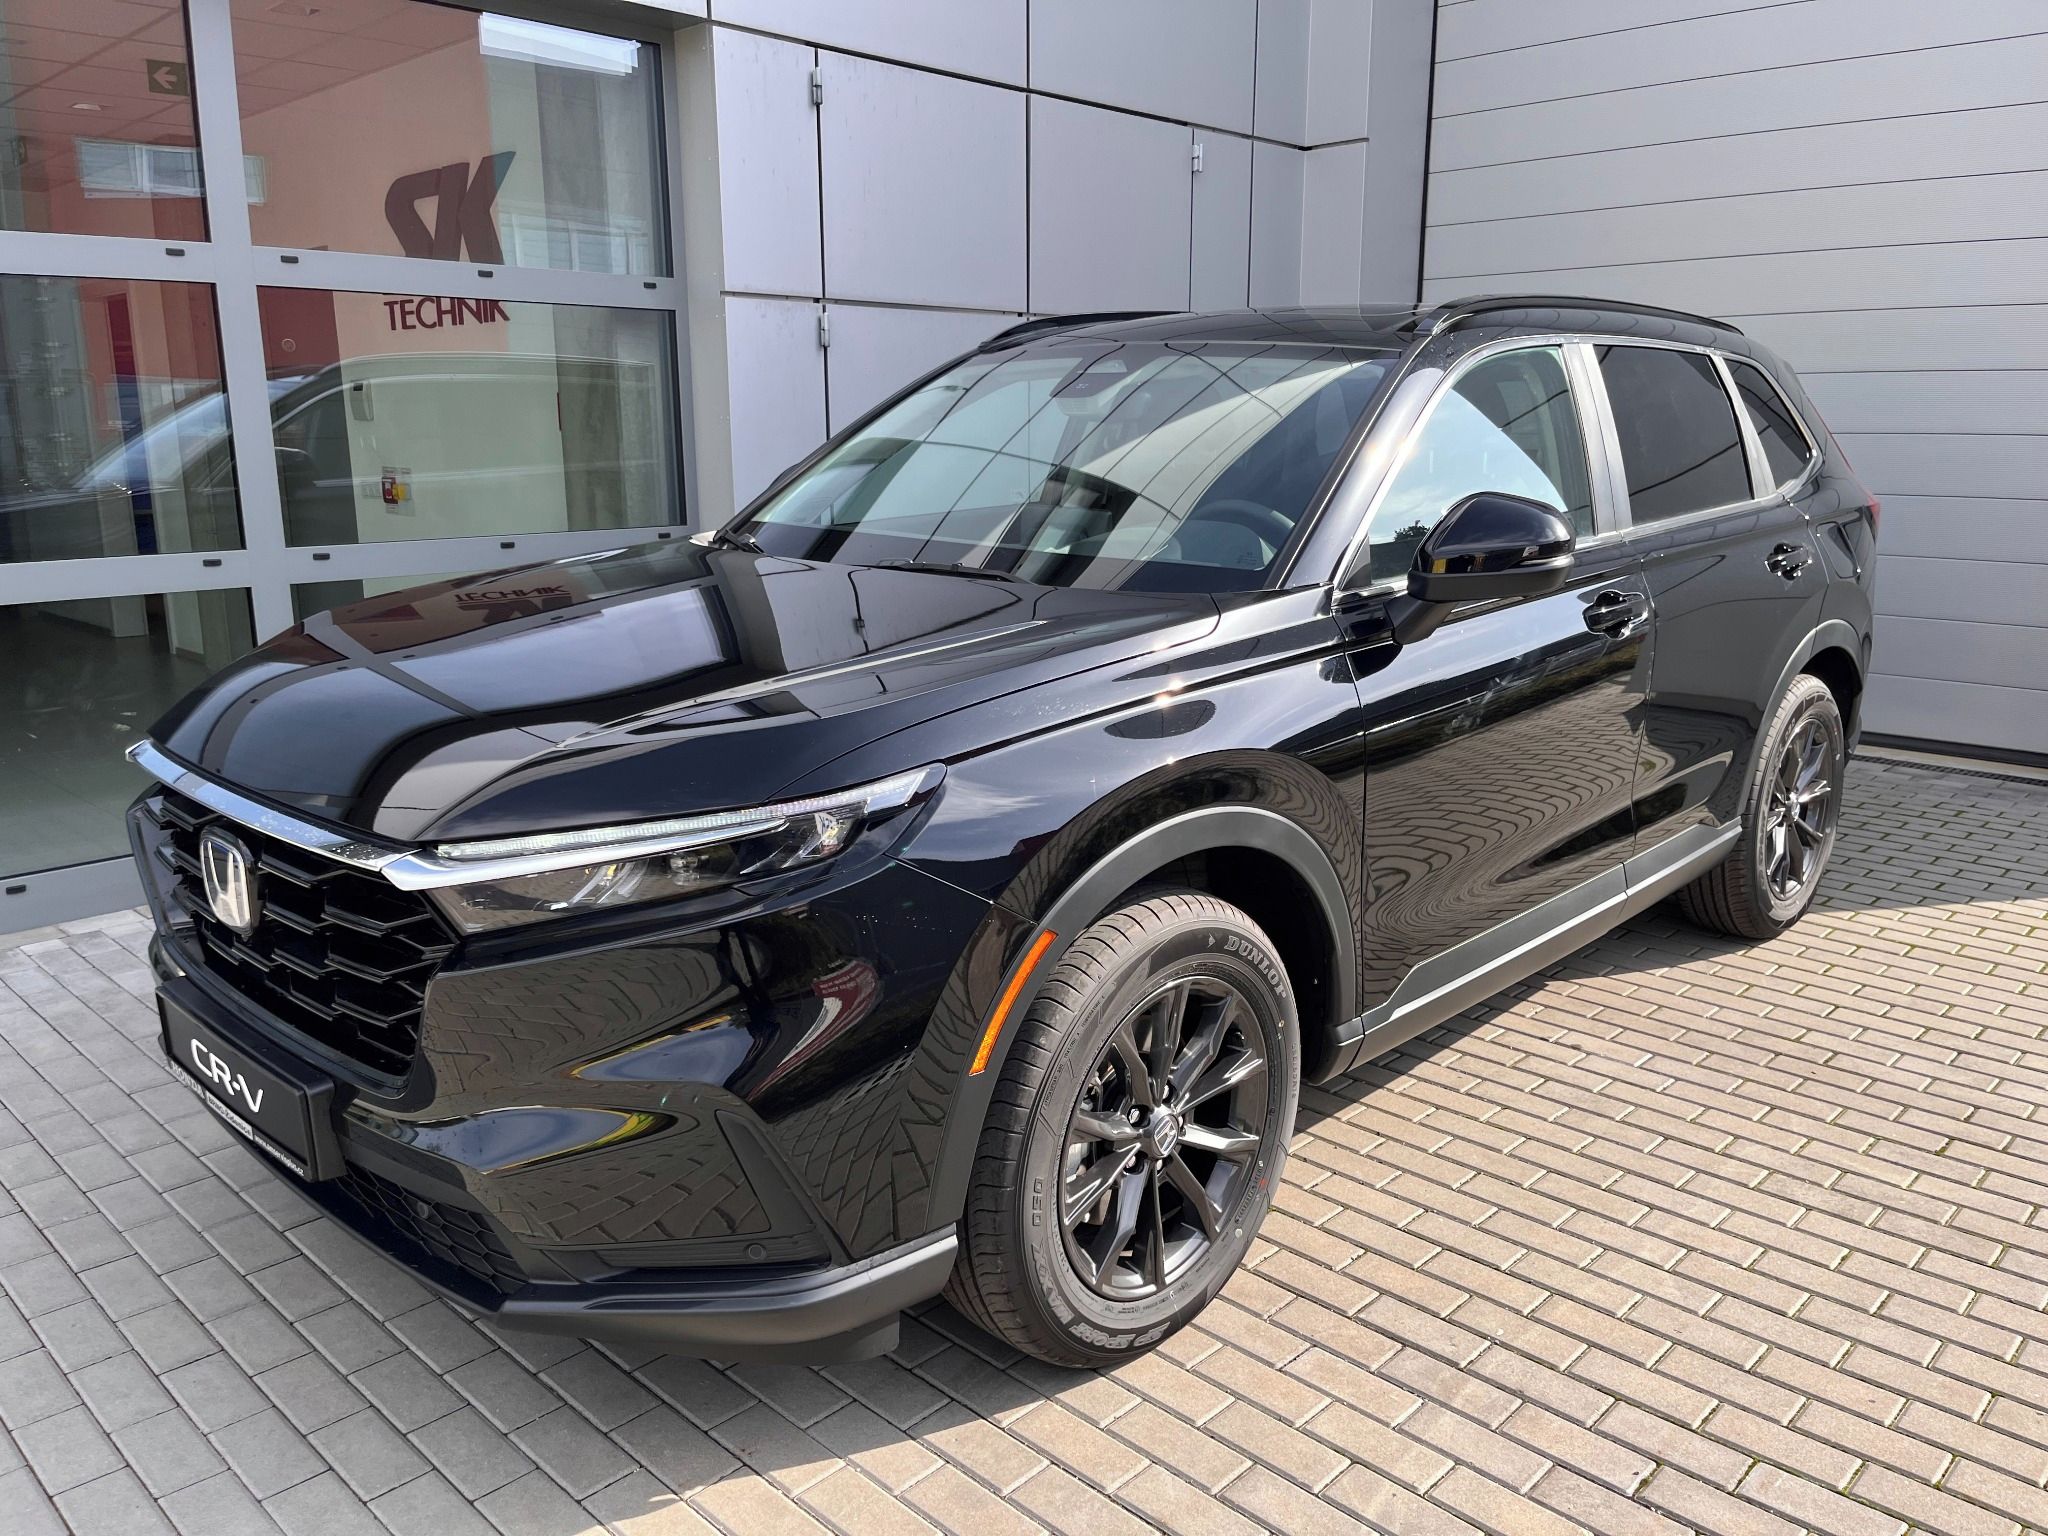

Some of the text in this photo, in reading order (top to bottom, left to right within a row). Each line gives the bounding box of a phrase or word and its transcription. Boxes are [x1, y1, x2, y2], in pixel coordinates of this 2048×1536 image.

[384, 296, 510, 330] TECHNIK
[1224, 935, 1286, 998] DUNLOP
[191, 1038, 263, 1112] CR-V
[1032, 1177, 1043, 1226] 050
[1031, 1239, 1075, 1325] MAXX
[1069, 1322, 1136, 1349] SPORT
